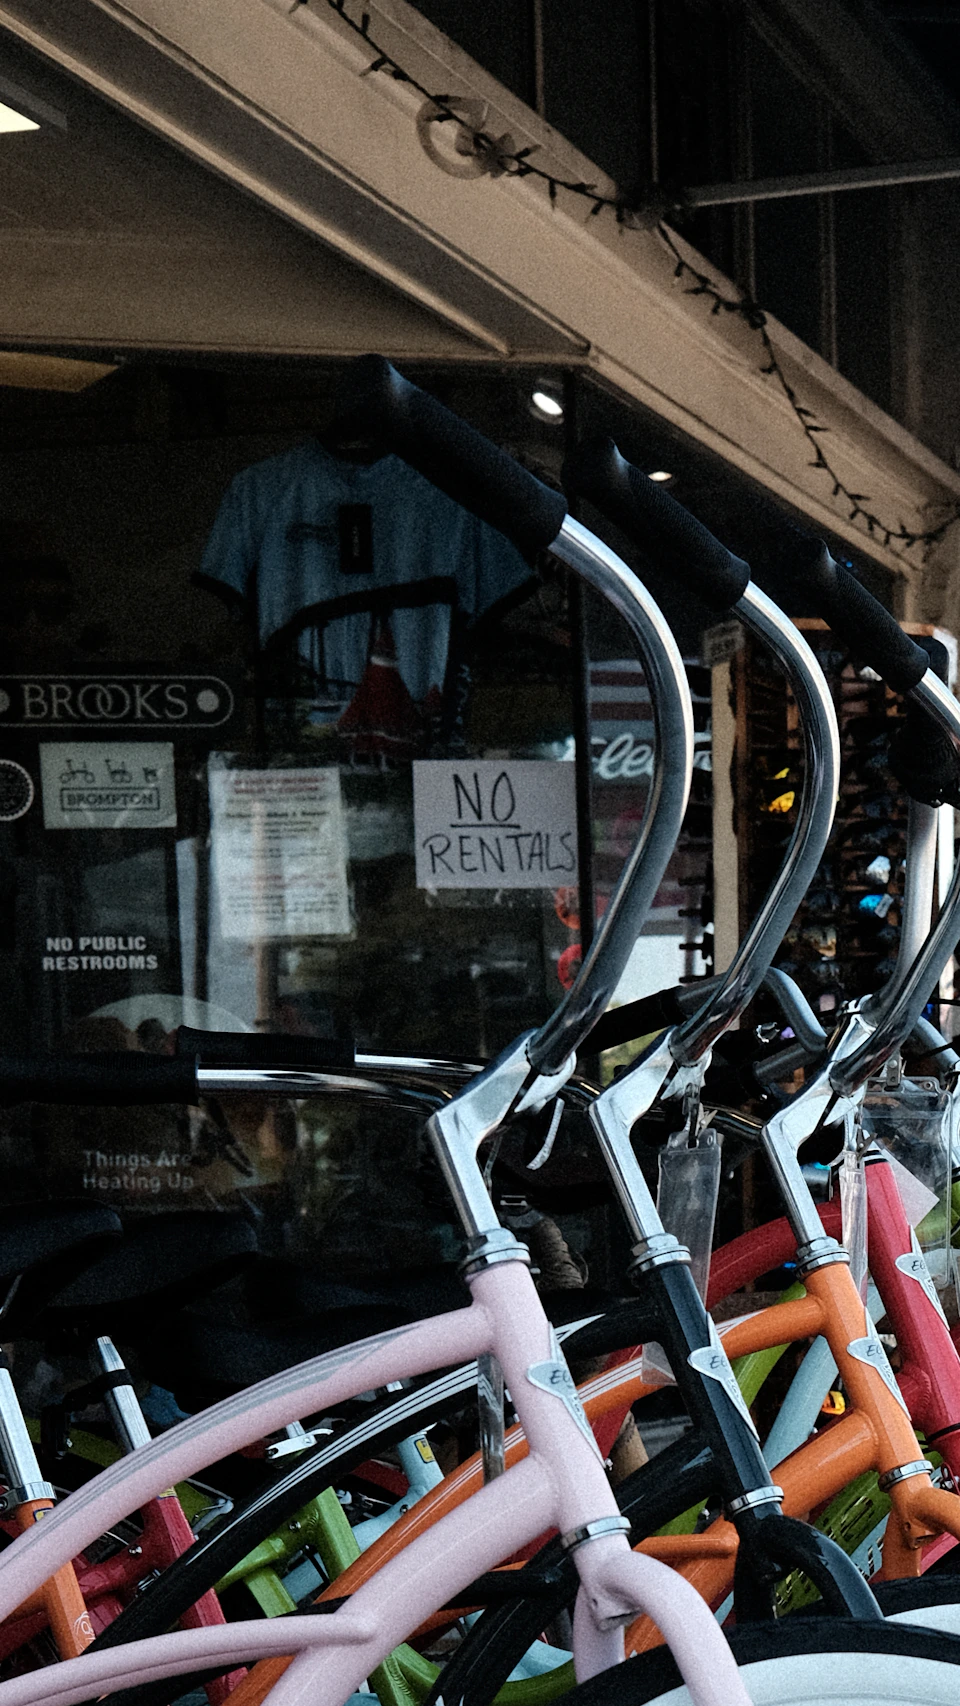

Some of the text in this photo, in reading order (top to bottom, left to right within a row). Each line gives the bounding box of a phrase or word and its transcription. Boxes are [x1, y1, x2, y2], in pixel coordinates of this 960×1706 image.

[23, 683, 189, 719] BROOKS
[66, 793, 153, 806] BROMPTON
[453, 772, 516, 822] NO
[422, 831, 576, 874] RENTALS
[46, 936, 147, 951] NO PUBLIC
[42, 954, 158, 971] RESTROOMS
[83, 1150, 192, 1174] Things Are
[82, 1172, 194, 1194] Heating Up
